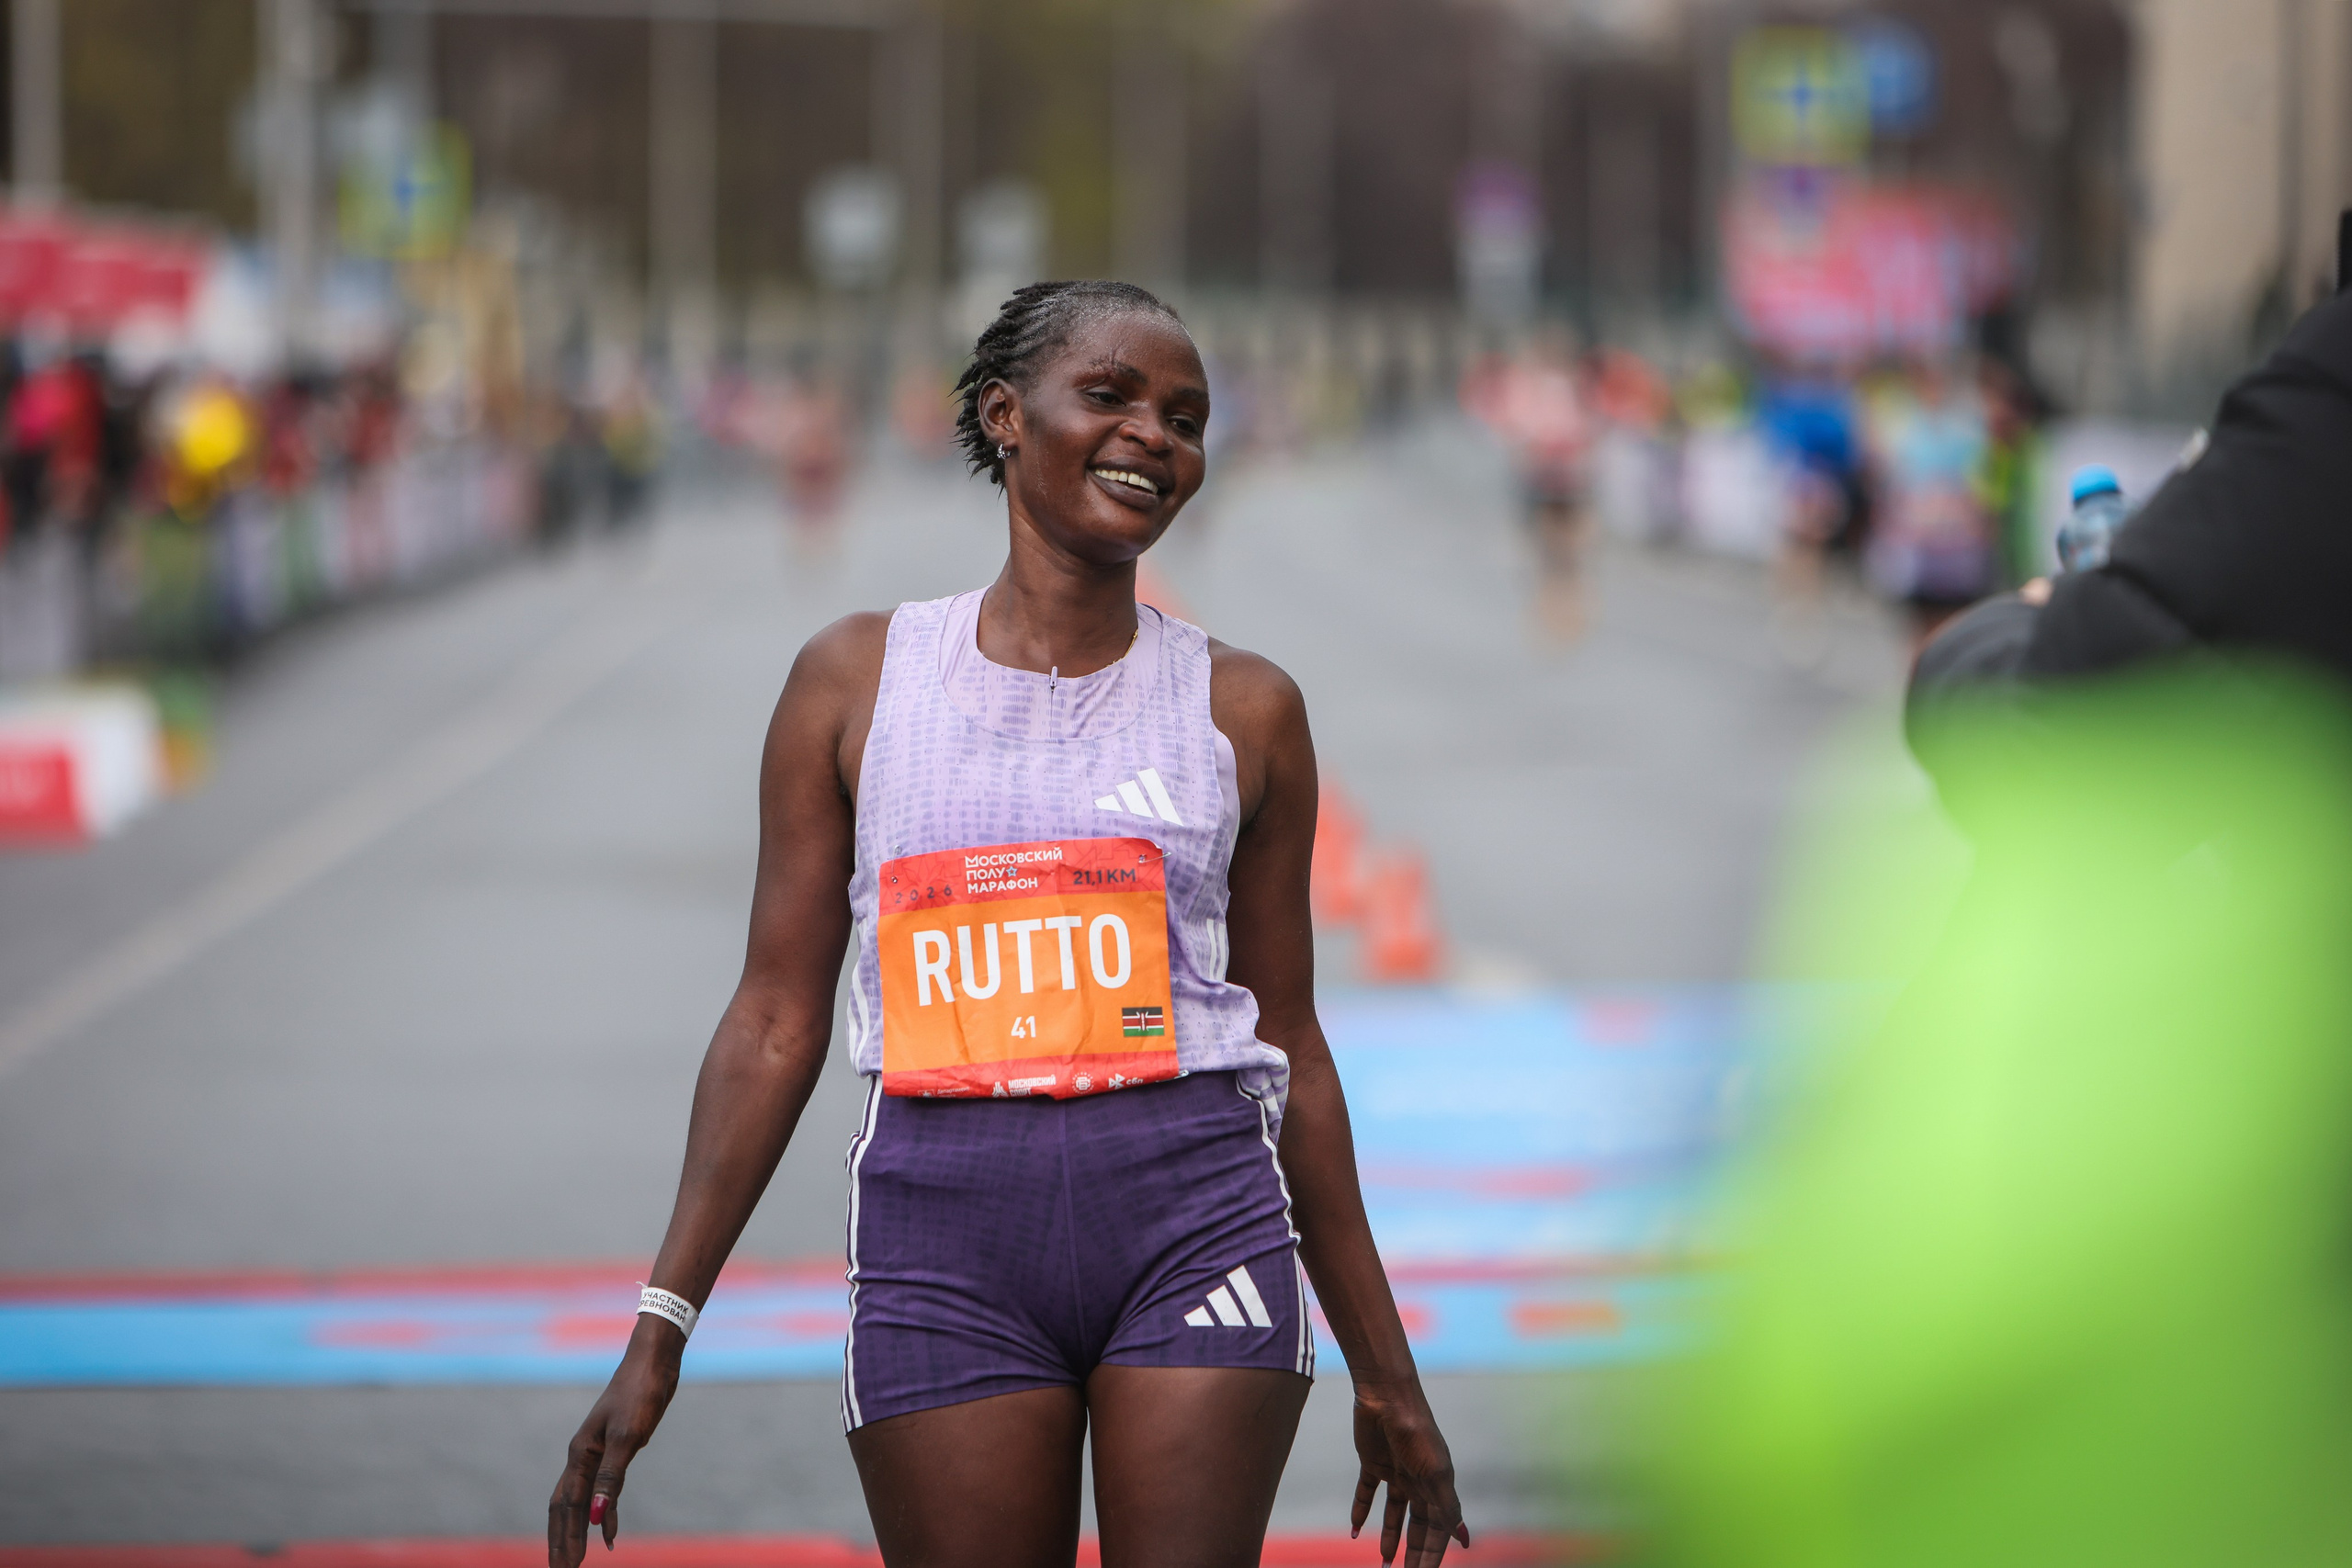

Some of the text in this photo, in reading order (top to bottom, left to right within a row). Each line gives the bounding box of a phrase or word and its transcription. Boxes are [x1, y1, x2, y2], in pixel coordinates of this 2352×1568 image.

[965, 847, 1063, 868] МОСКОВСКИЙ
[966, 867, 1006, 881] ПОЛУ
[967, 877, 1038, 894] МАРАФОН
[912, 913, 1132, 1006] RUTTO
[1011, 1016, 1036, 1039] 41
[1008, 1074, 1057, 1089] МОСКОВСКИЙ
[639, 1299, 686, 1323] РЕВНОВАН
[643, 1292, 689, 1314] УЧАСТНИК
